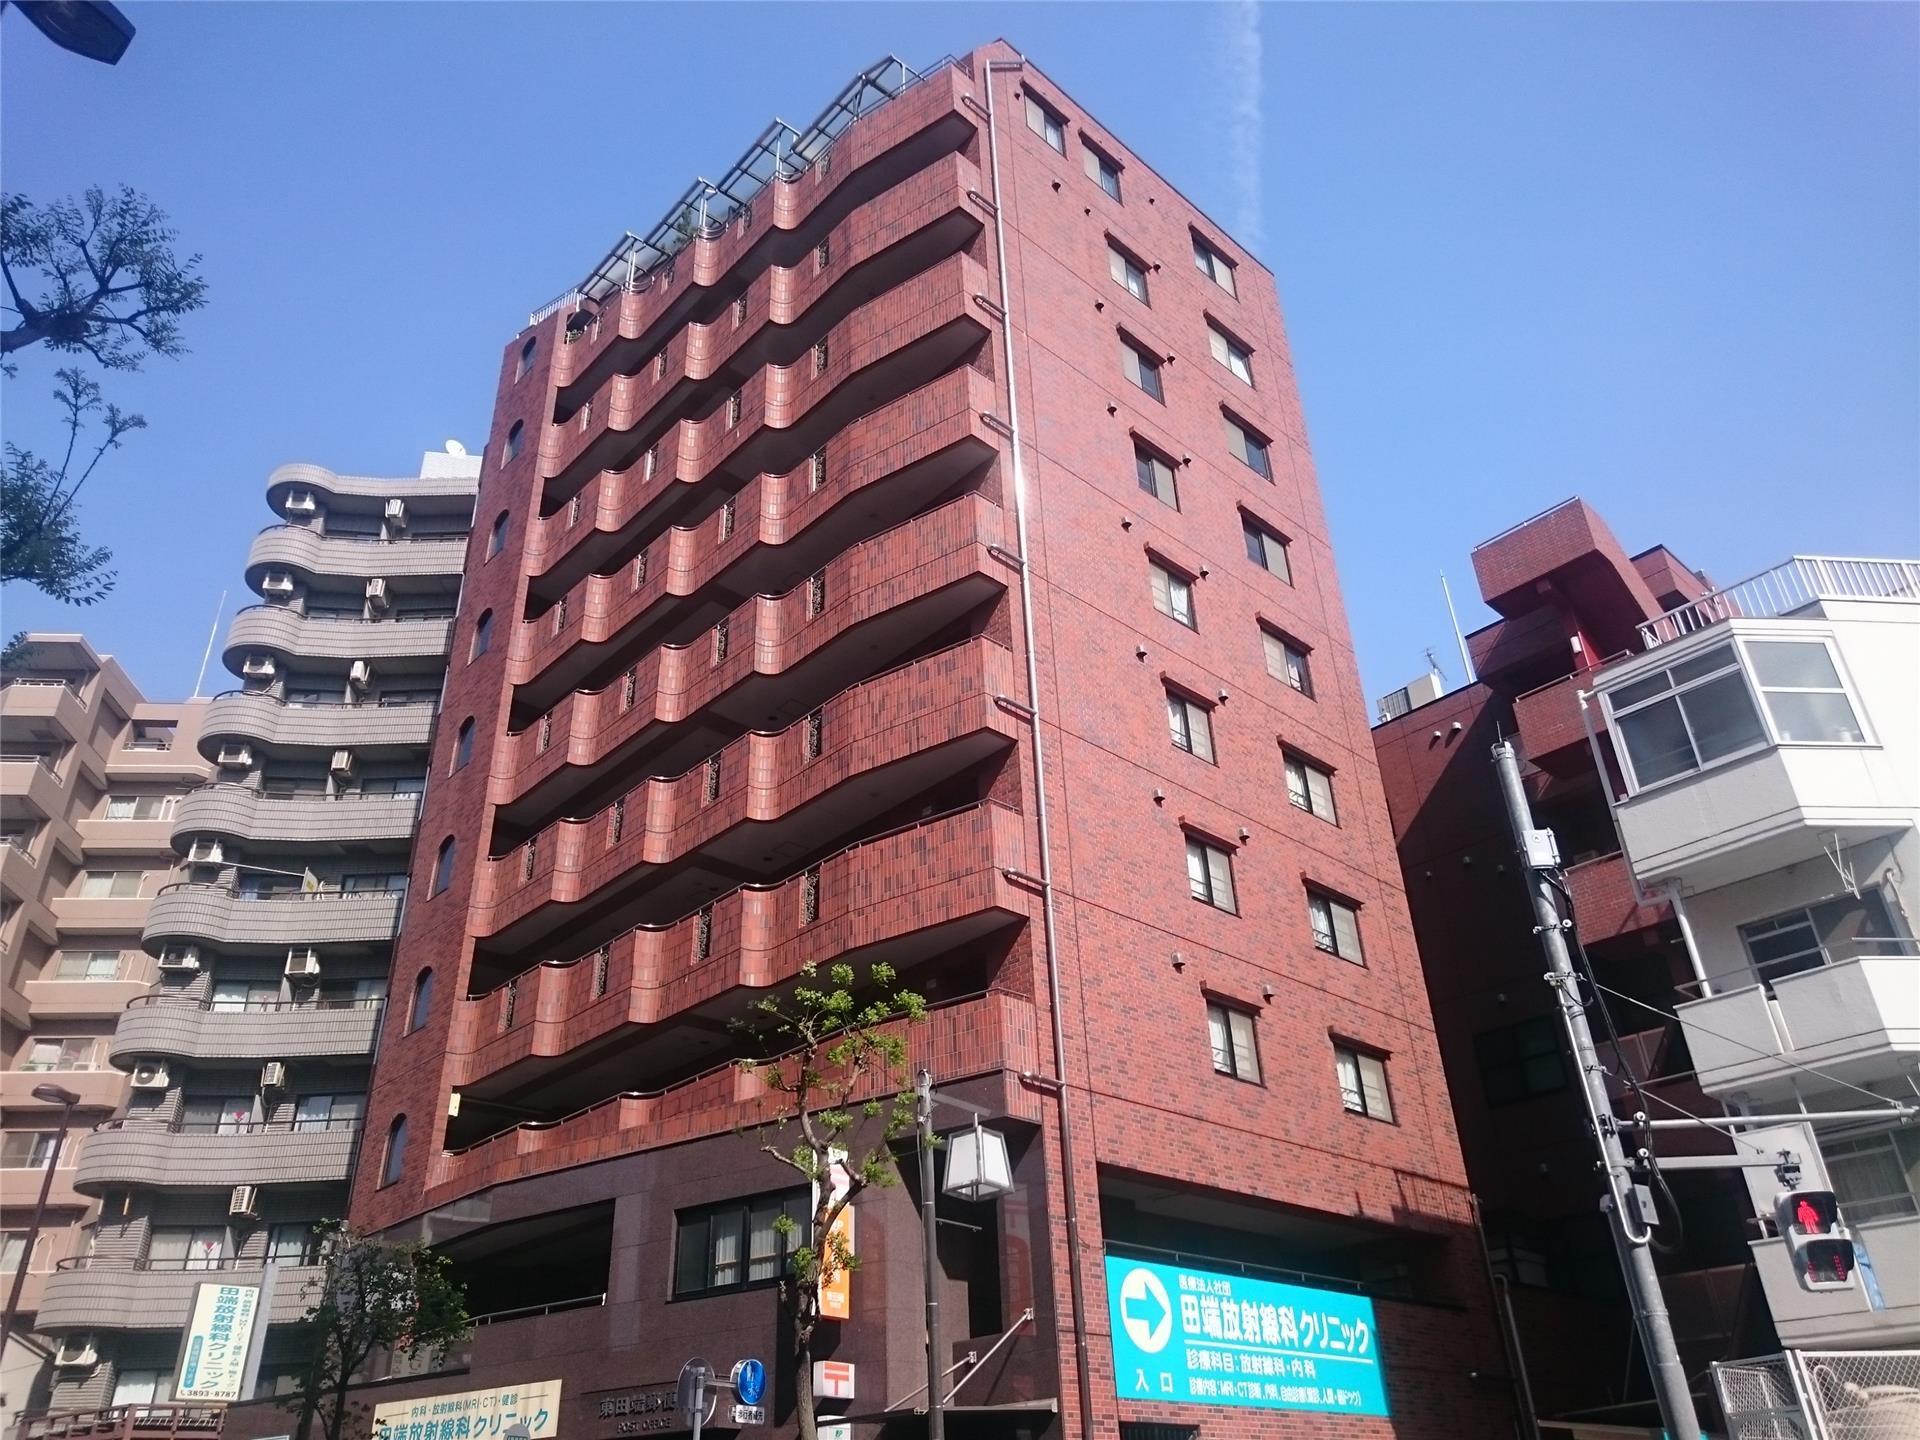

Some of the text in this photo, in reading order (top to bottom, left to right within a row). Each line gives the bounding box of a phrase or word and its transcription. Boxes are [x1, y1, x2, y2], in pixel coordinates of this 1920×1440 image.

[200, 1287, 240, 1389] 田端放射線科クリニック
[1180, 1294, 1369, 1355] 田端放射線科クリニック
[186, 1389, 237, 1398] 3893-8787
[1135, 1368, 1174, 1393] 入口
